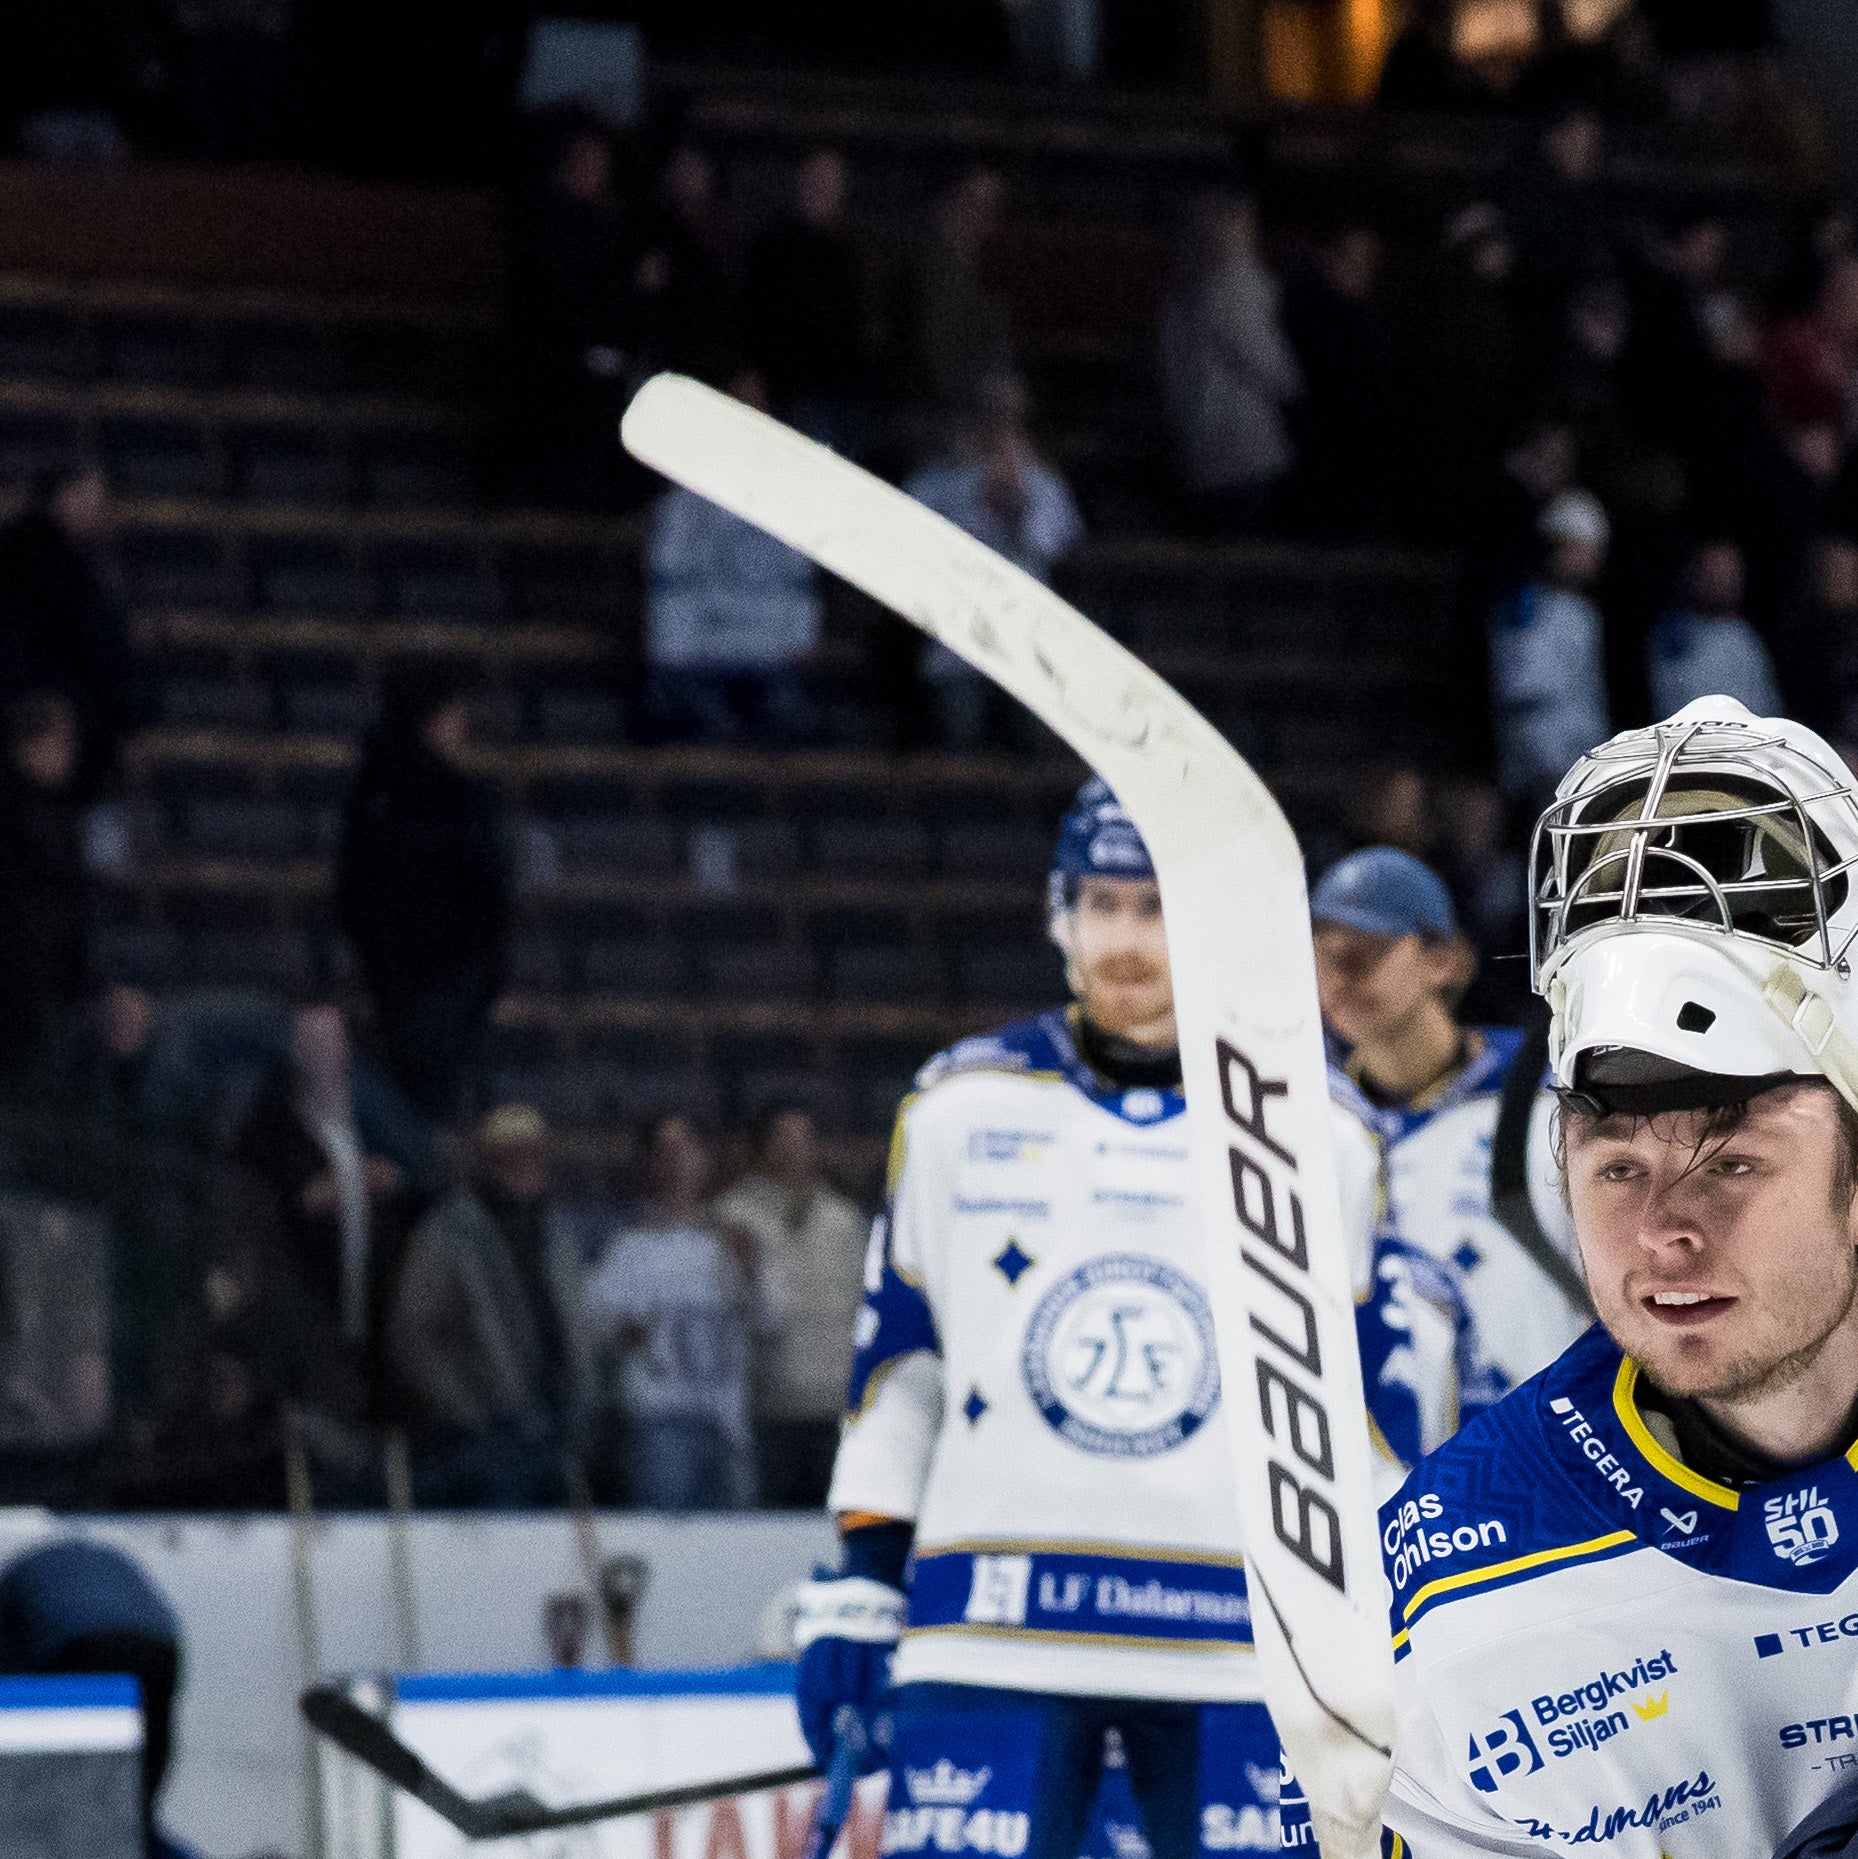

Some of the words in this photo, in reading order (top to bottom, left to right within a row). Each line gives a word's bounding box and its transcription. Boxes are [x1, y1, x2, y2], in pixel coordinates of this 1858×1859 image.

[1215, 1034, 1346, 1594] BAUER
[1561, 1409, 1645, 1510] TEGERA
[1383, 1492, 1444, 1556] Clas
[1763, 1486, 1830, 1522] SHL
[1765, 1506, 1840, 1560] 50
[1393, 1519, 1508, 1591] Ohlson
[1660, 1533, 1710, 1551] BAUER
[1530, 1648, 1679, 1727] Bergkvist
[1547, 1710, 1630, 1758] Siljan
[1658, 1808, 1690, 1834] since
[1690, 1795, 1723, 1816] 1941
